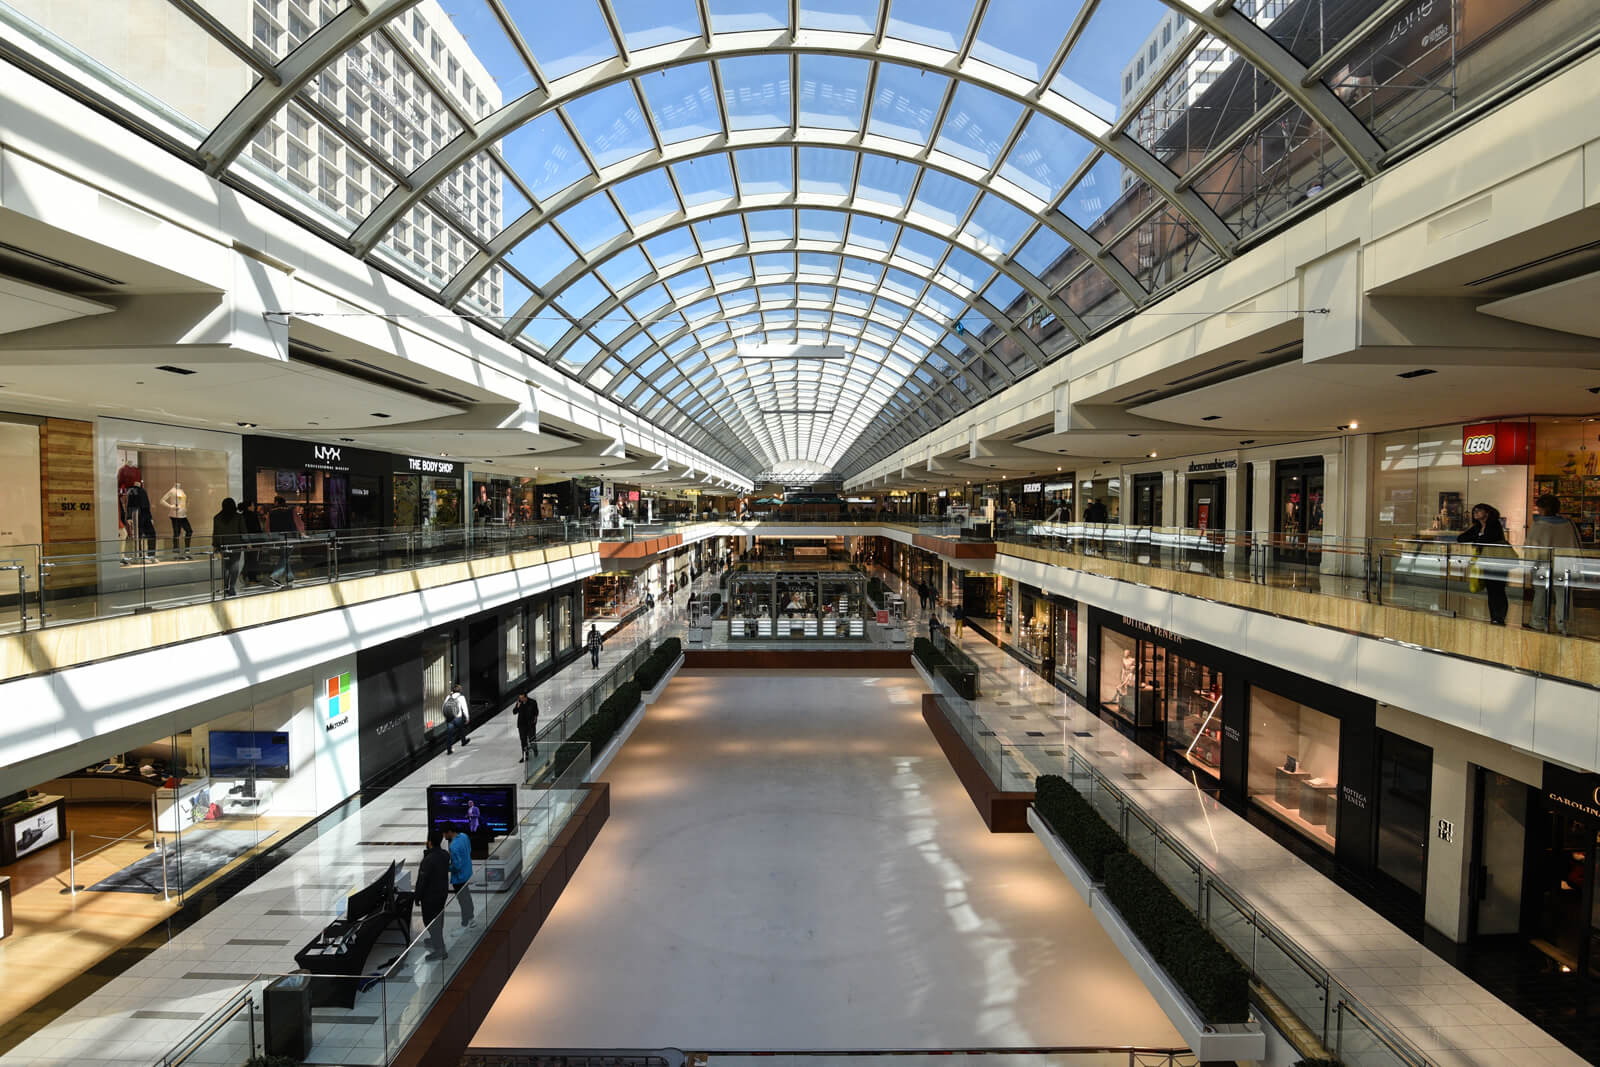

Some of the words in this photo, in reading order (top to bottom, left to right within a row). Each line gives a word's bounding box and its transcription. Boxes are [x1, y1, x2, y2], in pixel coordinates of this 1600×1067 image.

[1464, 435, 1495, 455] LEGO
[315, 446, 341, 464] NYX
[409, 459, 421, 471] THE
[422, 461, 438, 472] BODY
[438, 463, 453, 473] SHOP
[61, 502, 76, 511] SIX
[80, 502, 91, 511] 02
[326, 716, 349, 732] Microsoft
[1549, 793, 1600, 817] CAROLIN
